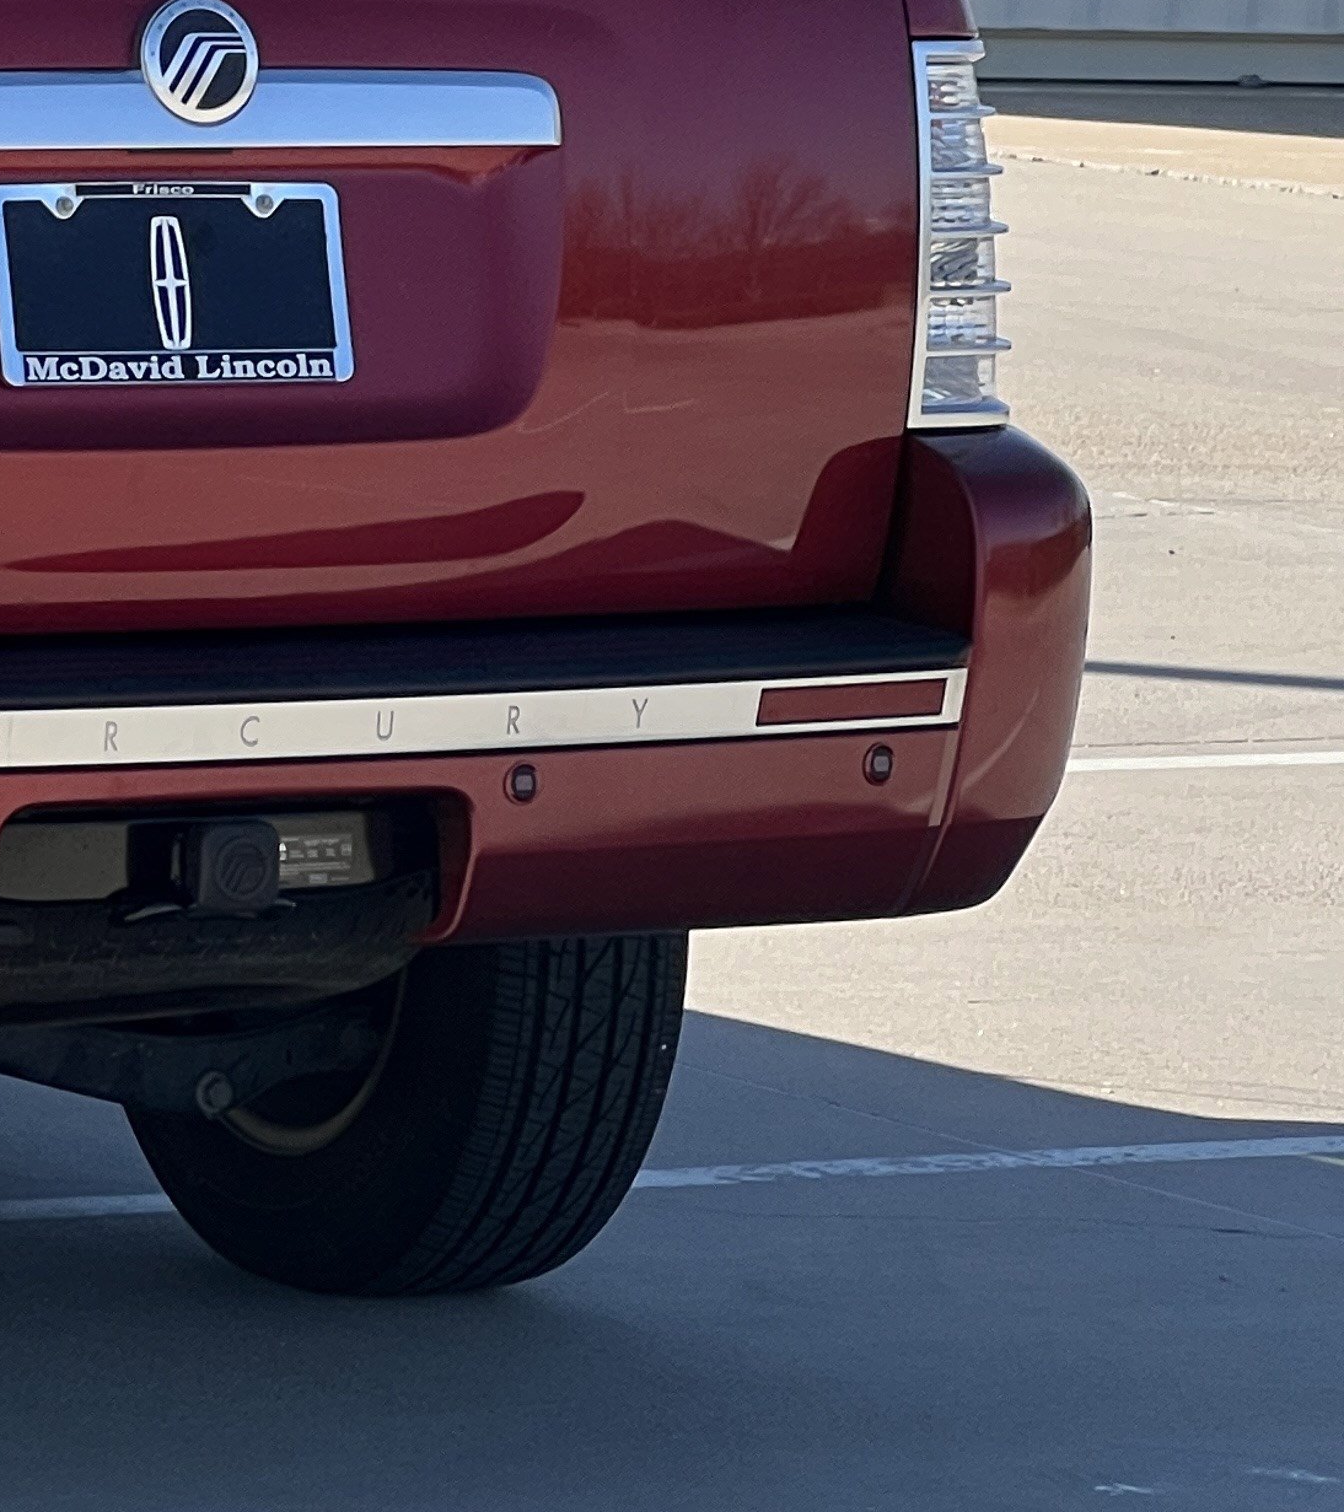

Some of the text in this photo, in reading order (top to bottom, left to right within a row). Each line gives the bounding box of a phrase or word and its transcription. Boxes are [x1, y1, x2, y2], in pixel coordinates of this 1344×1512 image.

[131, 183, 195, 196] Frisco
[26, 353, 334, 382] McDavid Lincoln
